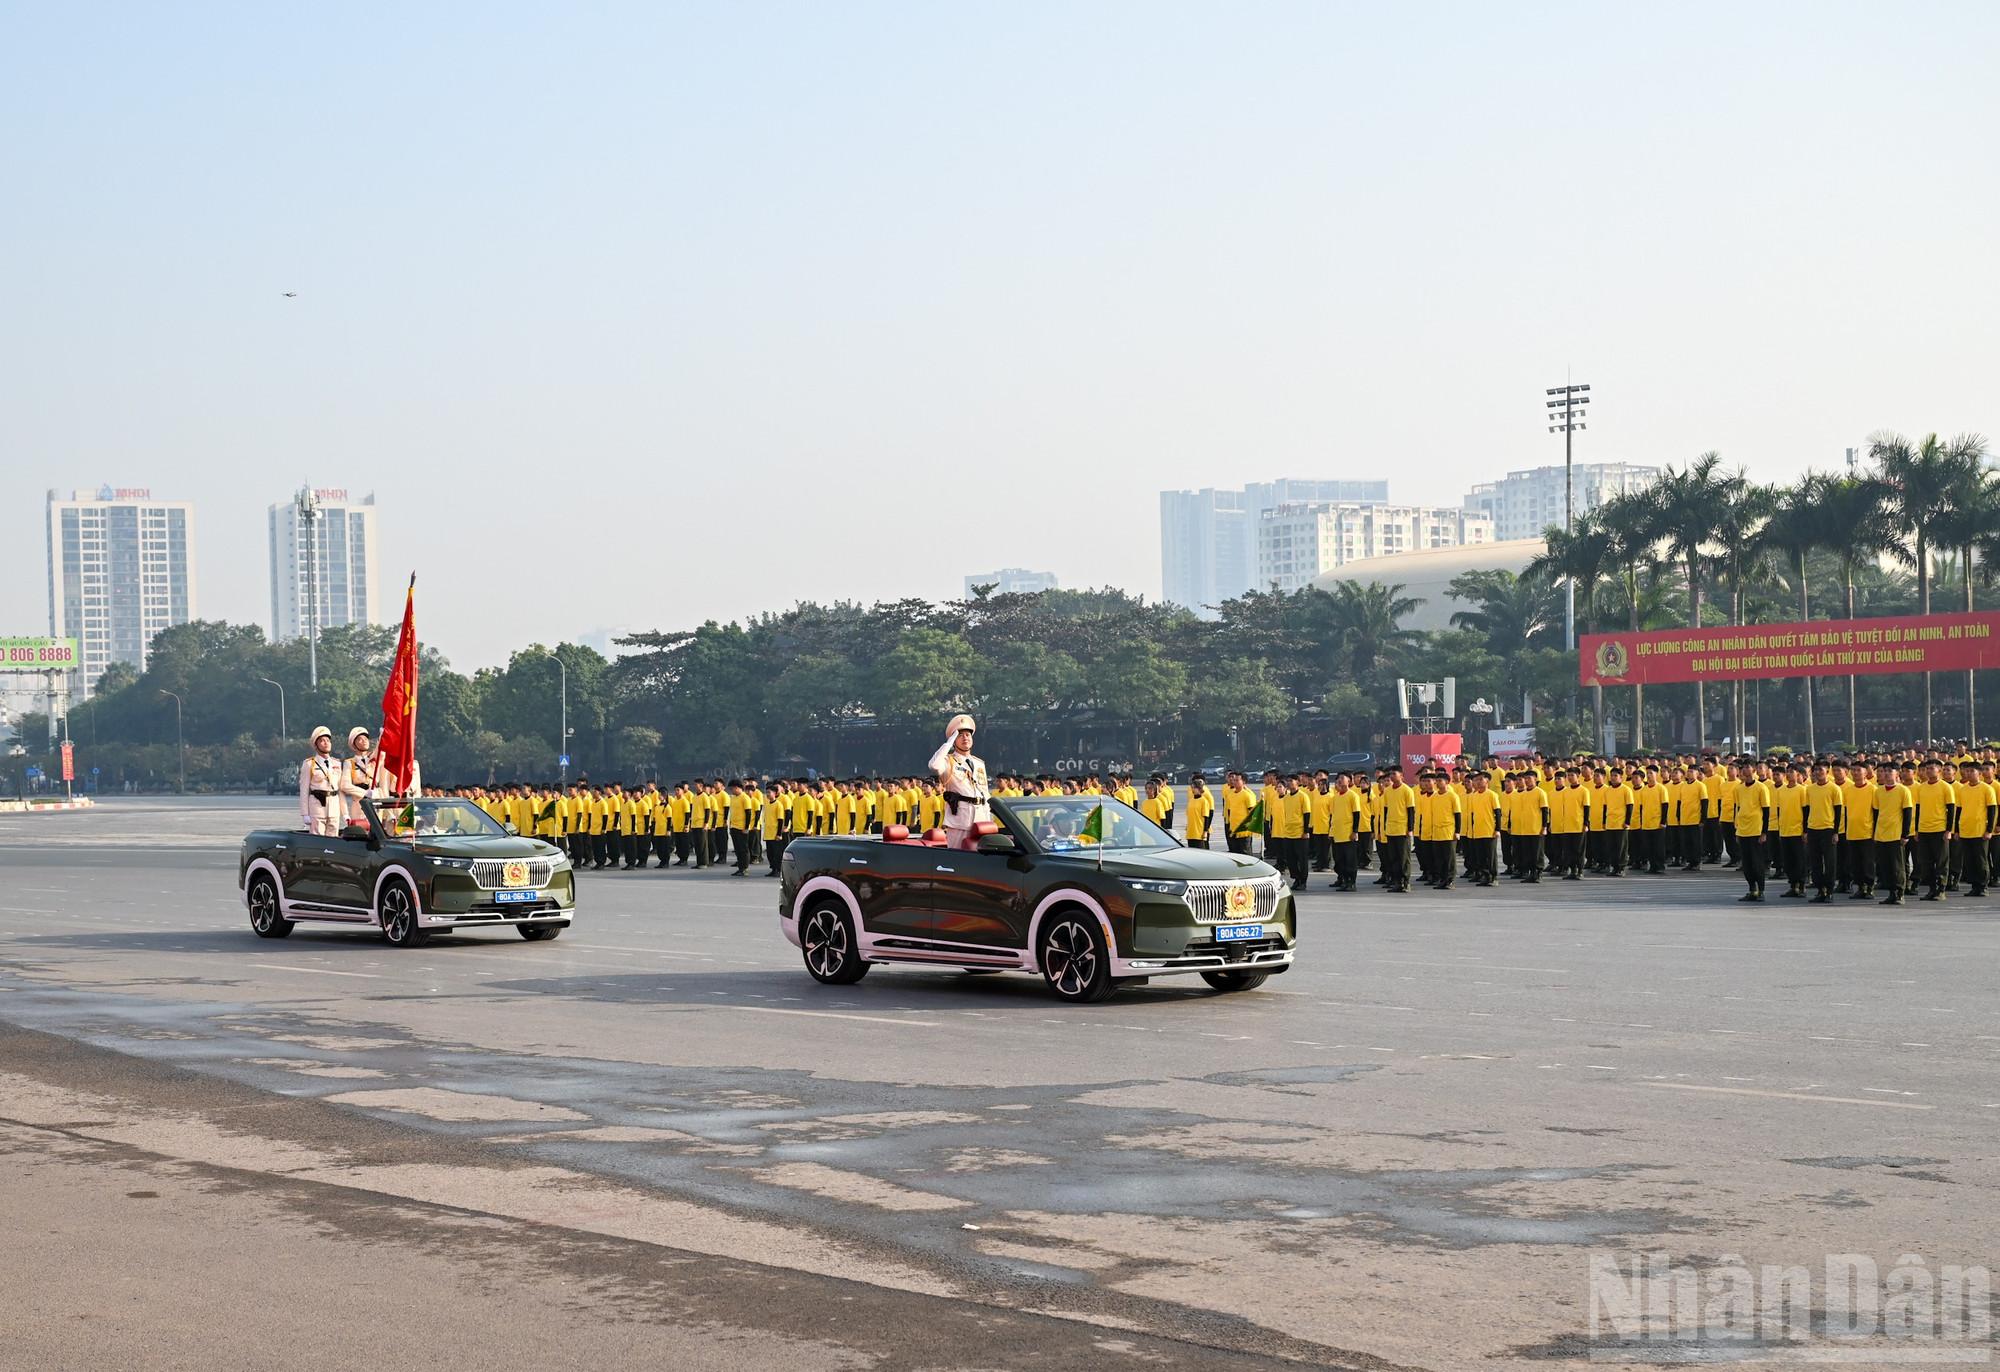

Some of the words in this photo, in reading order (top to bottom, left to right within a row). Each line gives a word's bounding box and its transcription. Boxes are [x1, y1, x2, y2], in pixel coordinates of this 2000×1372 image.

[1636, 642, 1651, 656] LỰC
[1654, 640, 1681, 657] LƯỢNG
[1682, 637, 1706, 653] CÔNG
[1707, 638, 1720, 651] AN
[1722, 636, 1747, 650] NHÂN
[1748, 635, 1767, 649] DÂN
[1769, 631, 1797, 649] QUYẾT
[1799, 631, 1819, 647] TÂM
[1821, 629, 1839, 646] BẢO
[1842, 629, 1853, 647] VỆ
[1855, 628, 1883, 646] TUYỆT
[1885, 625, 1901, 642] ĐỐI
[1903, 628, 1917, 641] AN
[1919, 626, 1946, 641] NINH,
[1948, 626, 1962, 638] AN
[1964, 621, 1990, 638] TOÀN
[10, 647, 34, 661] 806
[39, 647, 72, 661] 8888
[1692, 658, 1706, 674] ĐẠI
[1708, 656, 1723, 673] HỘI
[1725, 658, 1740, 673] ĐẠI
[1742, 652, 1761, 670] BIỂU
[1764, 653, 1788, 668] TOÀN
[1790, 650, 1814, 668] QUỐC
[1816, 649, 1835, 666] LẦN
[1836, 649, 1855, 665] THỨ
[1856, 650, 1872, 664] XIV
[1874, 647, 1893, 663] CỦA
[1895, 645, 1925, 662] ĐẢNG!
